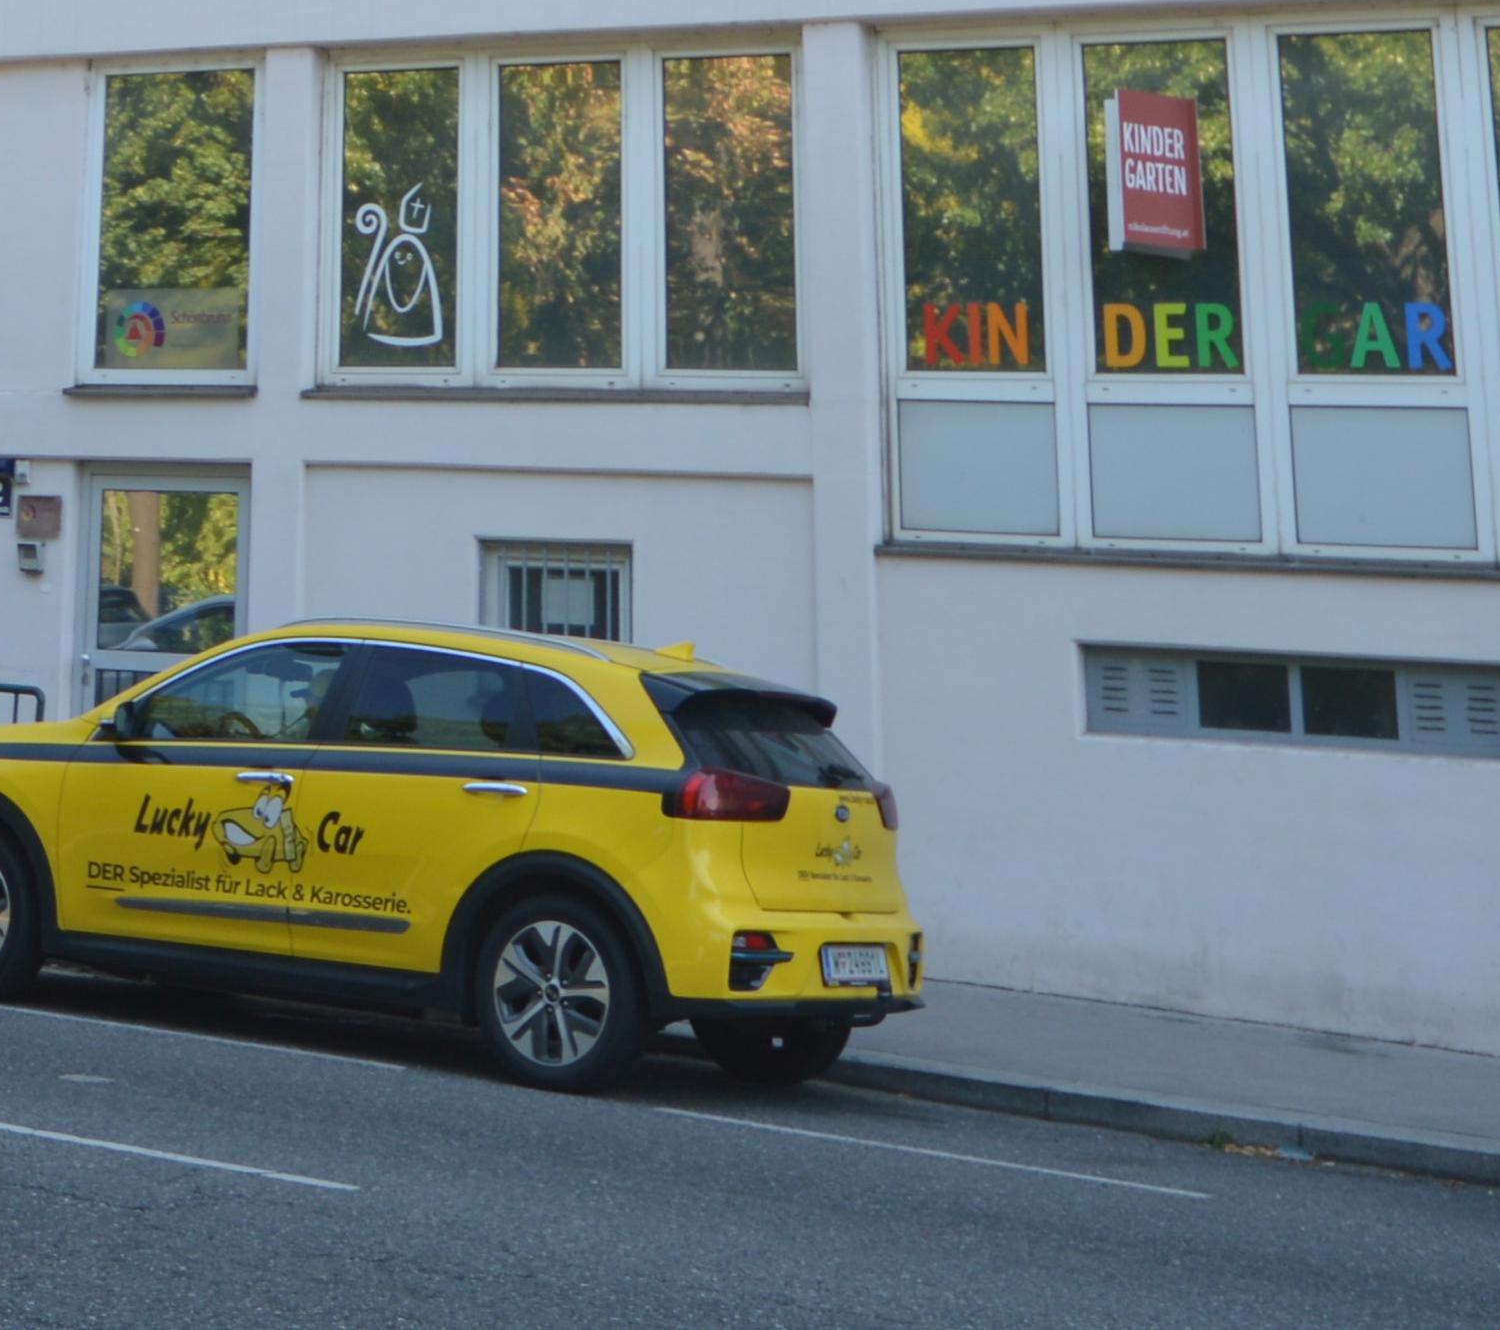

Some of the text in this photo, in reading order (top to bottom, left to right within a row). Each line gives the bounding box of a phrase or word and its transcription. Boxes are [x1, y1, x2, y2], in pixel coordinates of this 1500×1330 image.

[1122, 121, 1185, 160] KINDER
[1124, 158, 1188, 197] GARTEN
[134, 794, 365, 856] Lucky Car
[87, 861, 412, 915] DER Spezialist für Lack & Karosserie.
